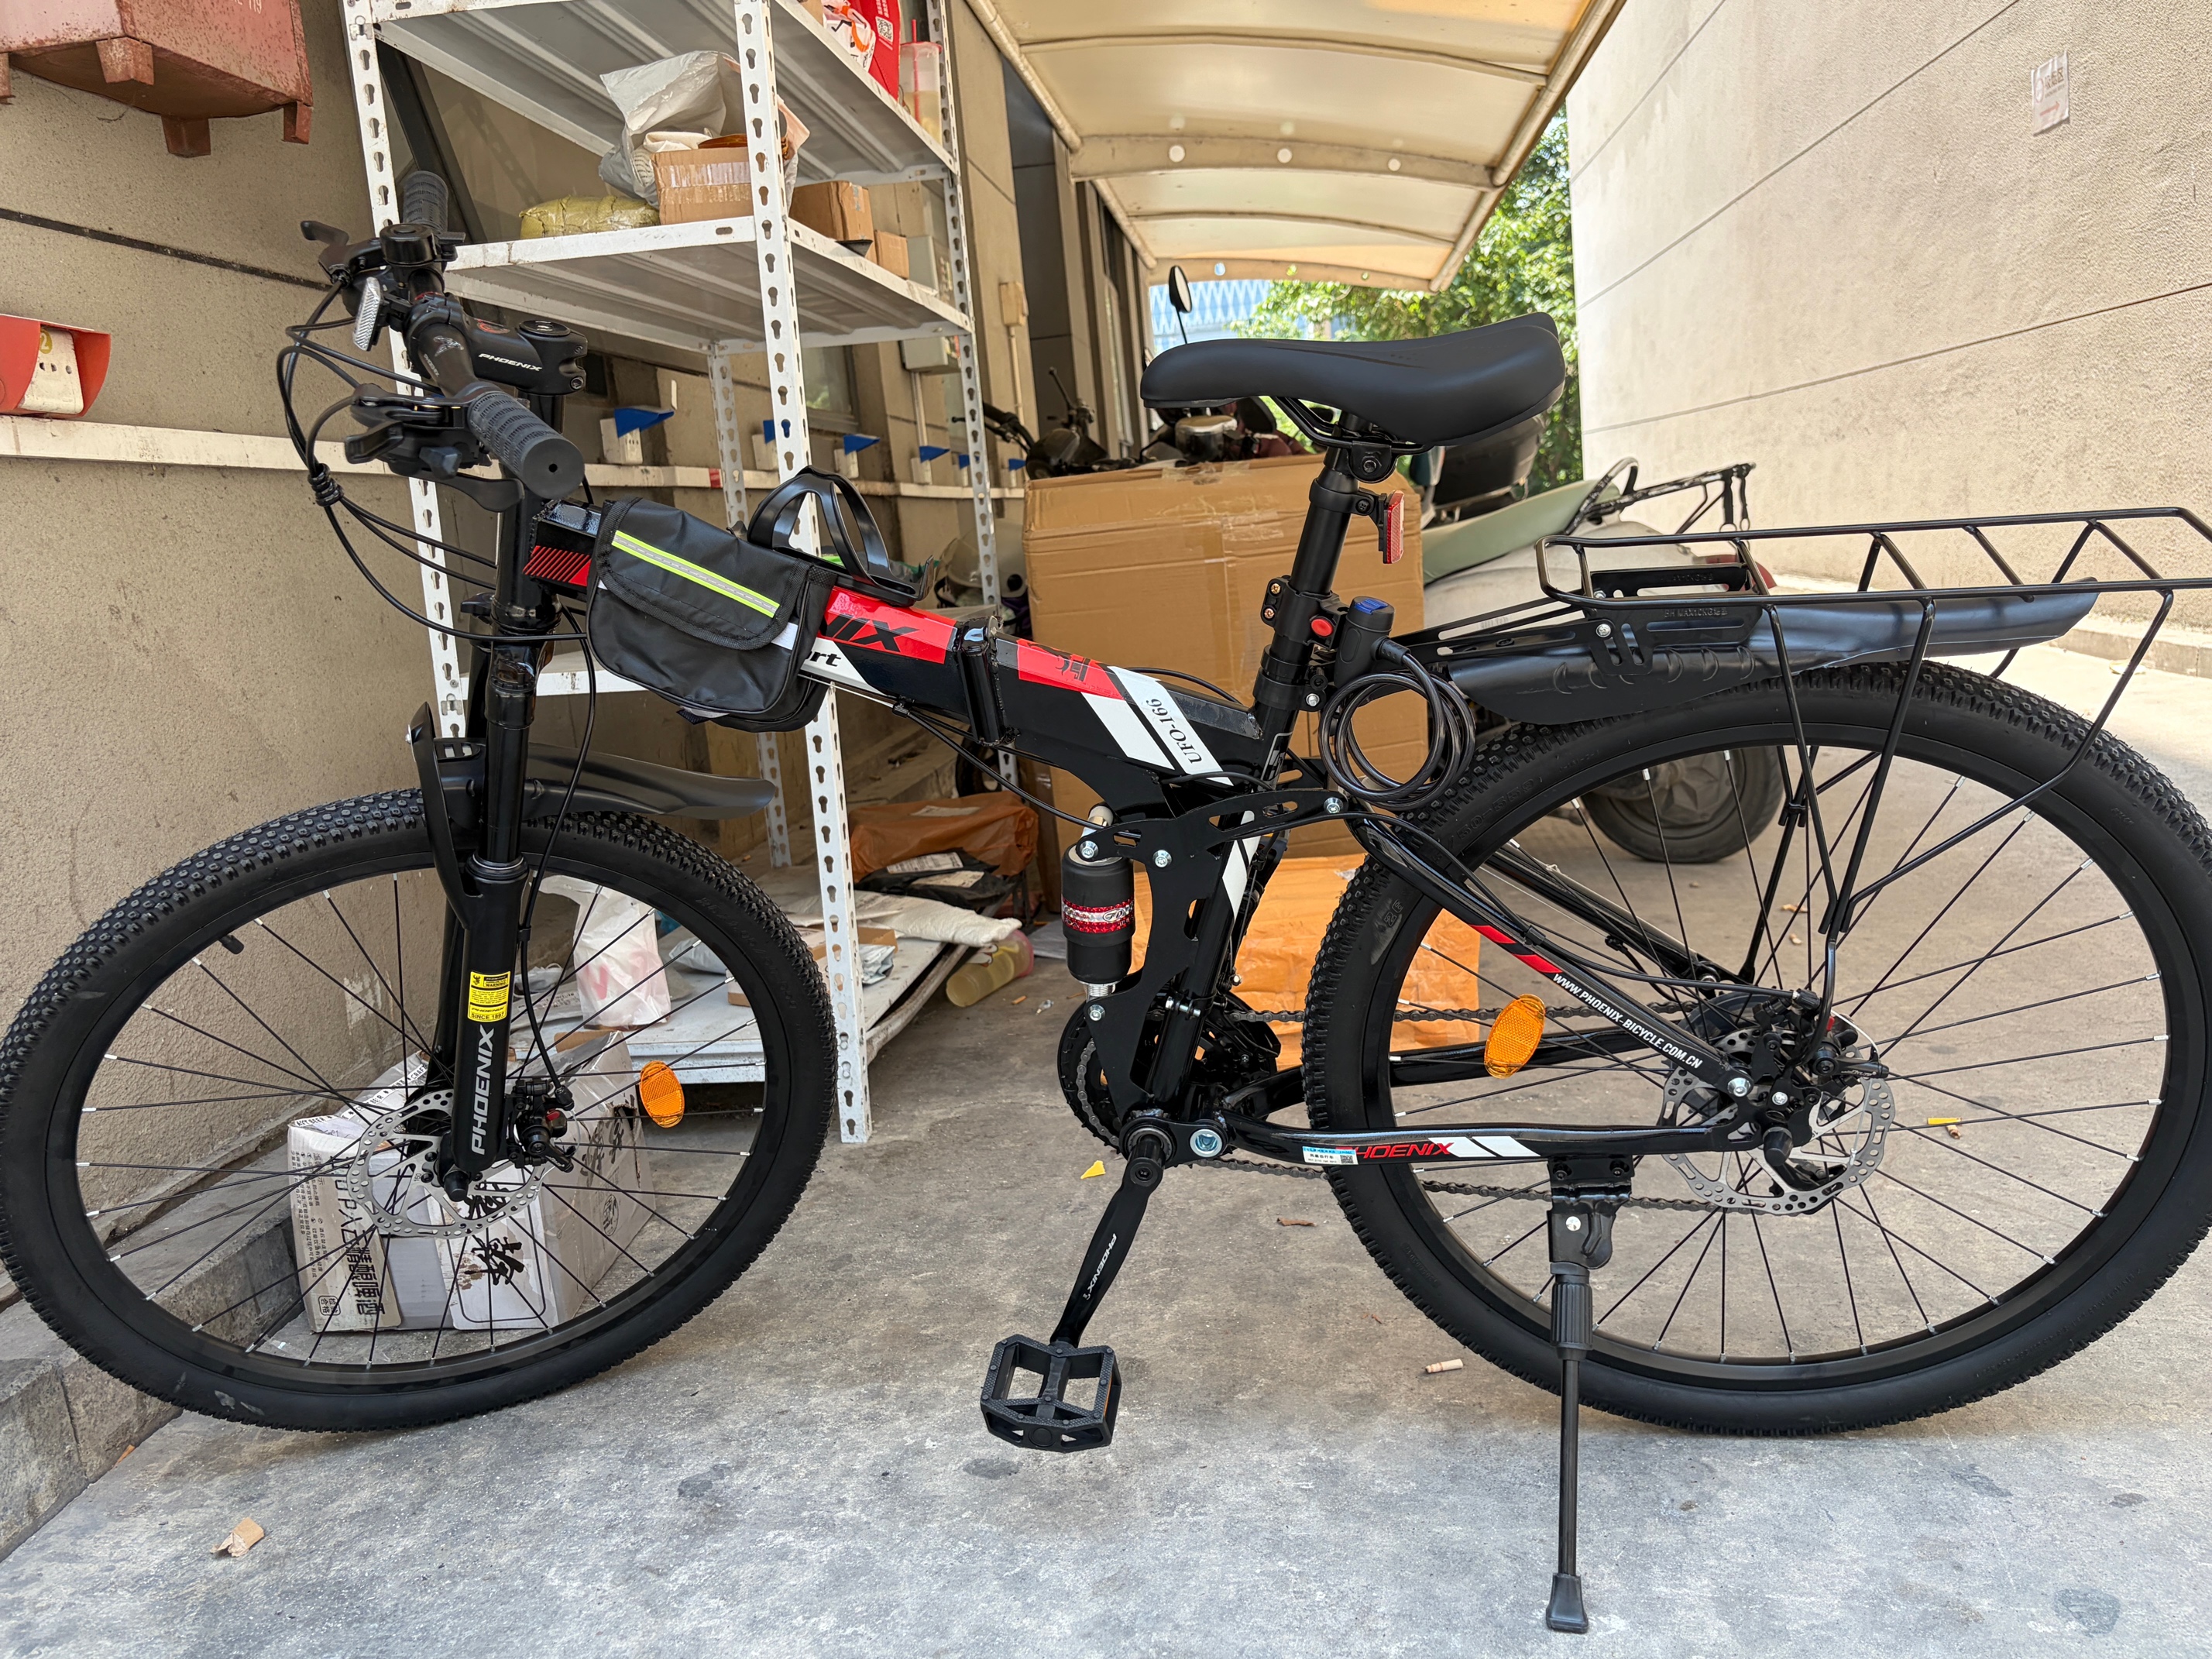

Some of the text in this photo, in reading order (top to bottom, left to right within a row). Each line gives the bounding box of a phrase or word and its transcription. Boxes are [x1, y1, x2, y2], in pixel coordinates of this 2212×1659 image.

[478, 352, 542, 372] PHOENIX
[1146, 699, 1203, 764] UFO-166
[1553, 974, 1703, 1069] WWW.PHOENIX-BICYCLE.COM.CN
[472, 1024, 495, 1155] PHOENIX
[1336, 1142, 1454, 1159] HOENIX
[1087, 1233, 1117, 1293] PHOENIX
